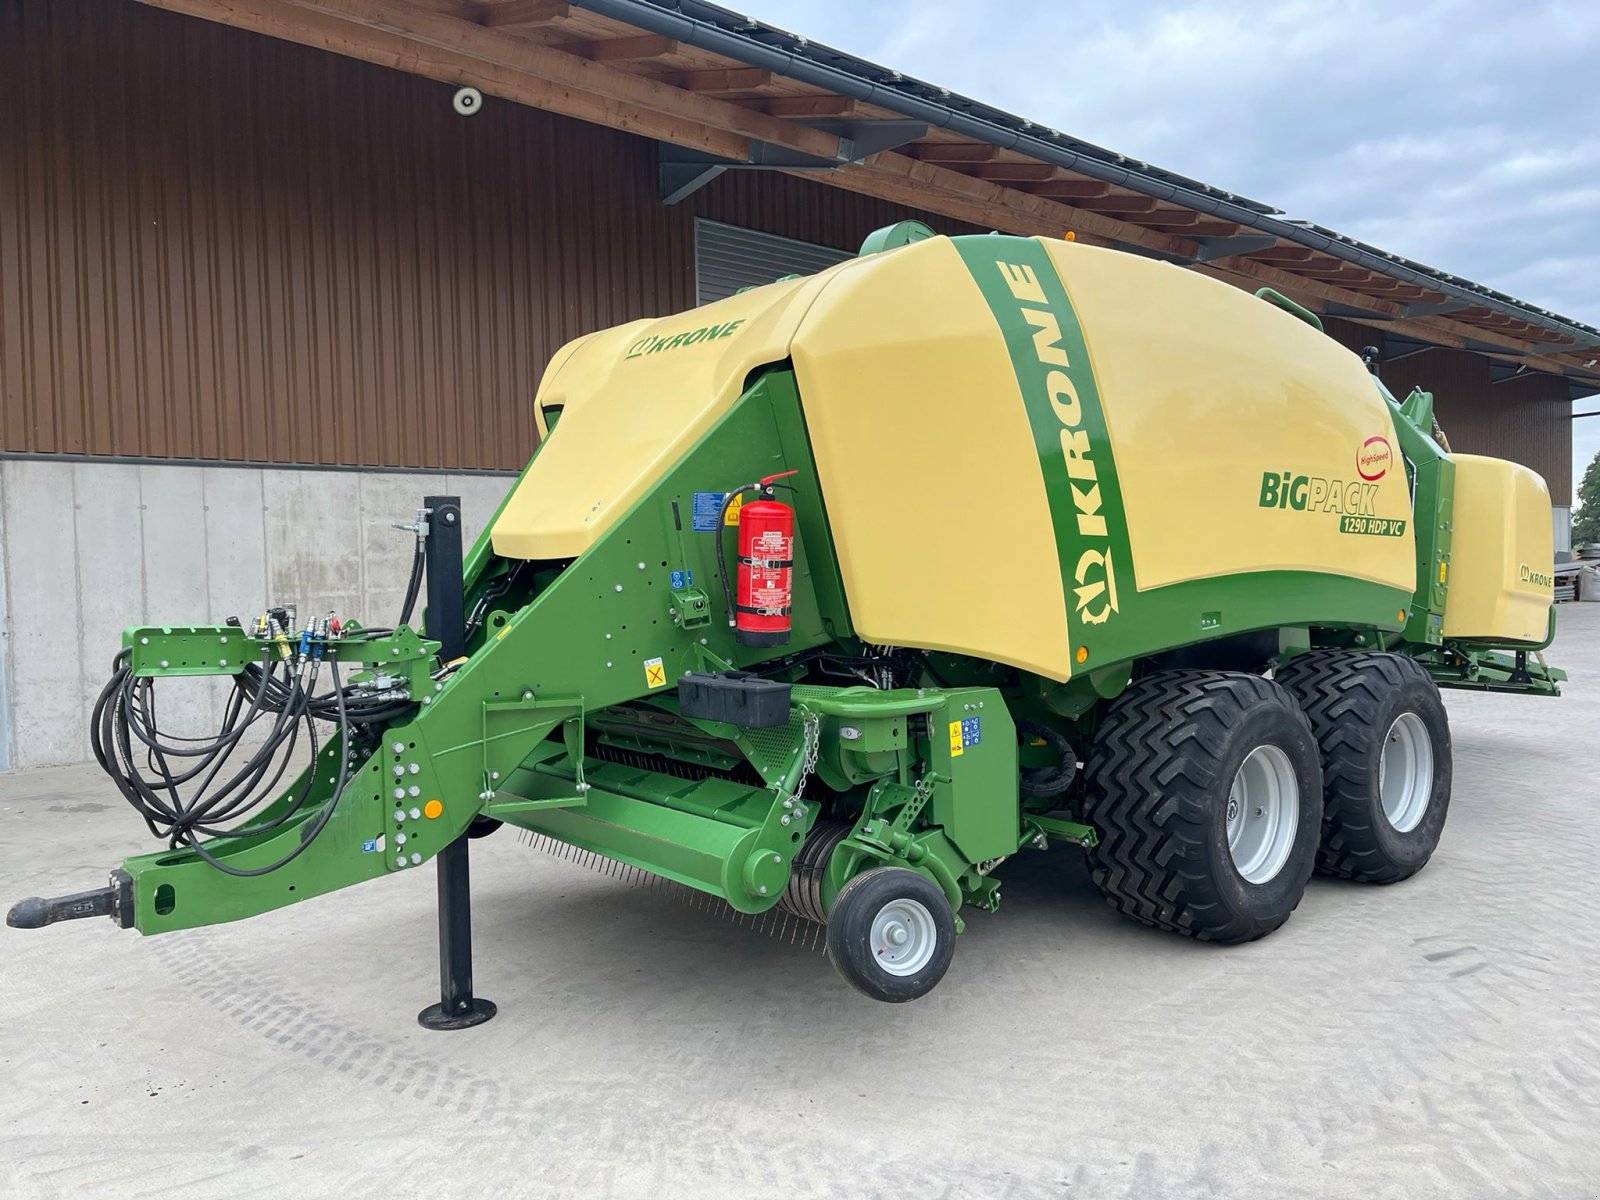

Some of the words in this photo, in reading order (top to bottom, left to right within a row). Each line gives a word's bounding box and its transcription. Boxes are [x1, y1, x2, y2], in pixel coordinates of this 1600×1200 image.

[646, 318, 747, 355] KRONE
[996, 260, 1108, 537] KRONE
[1360, 451, 1389, 466] HighSpeed
[1344, 517, 1366, 533] 1290
[1368, 519, 1388, 535] HDP
[1389, 521, 1402, 536] VC
[1529, 572, 1552, 588] KRONE
